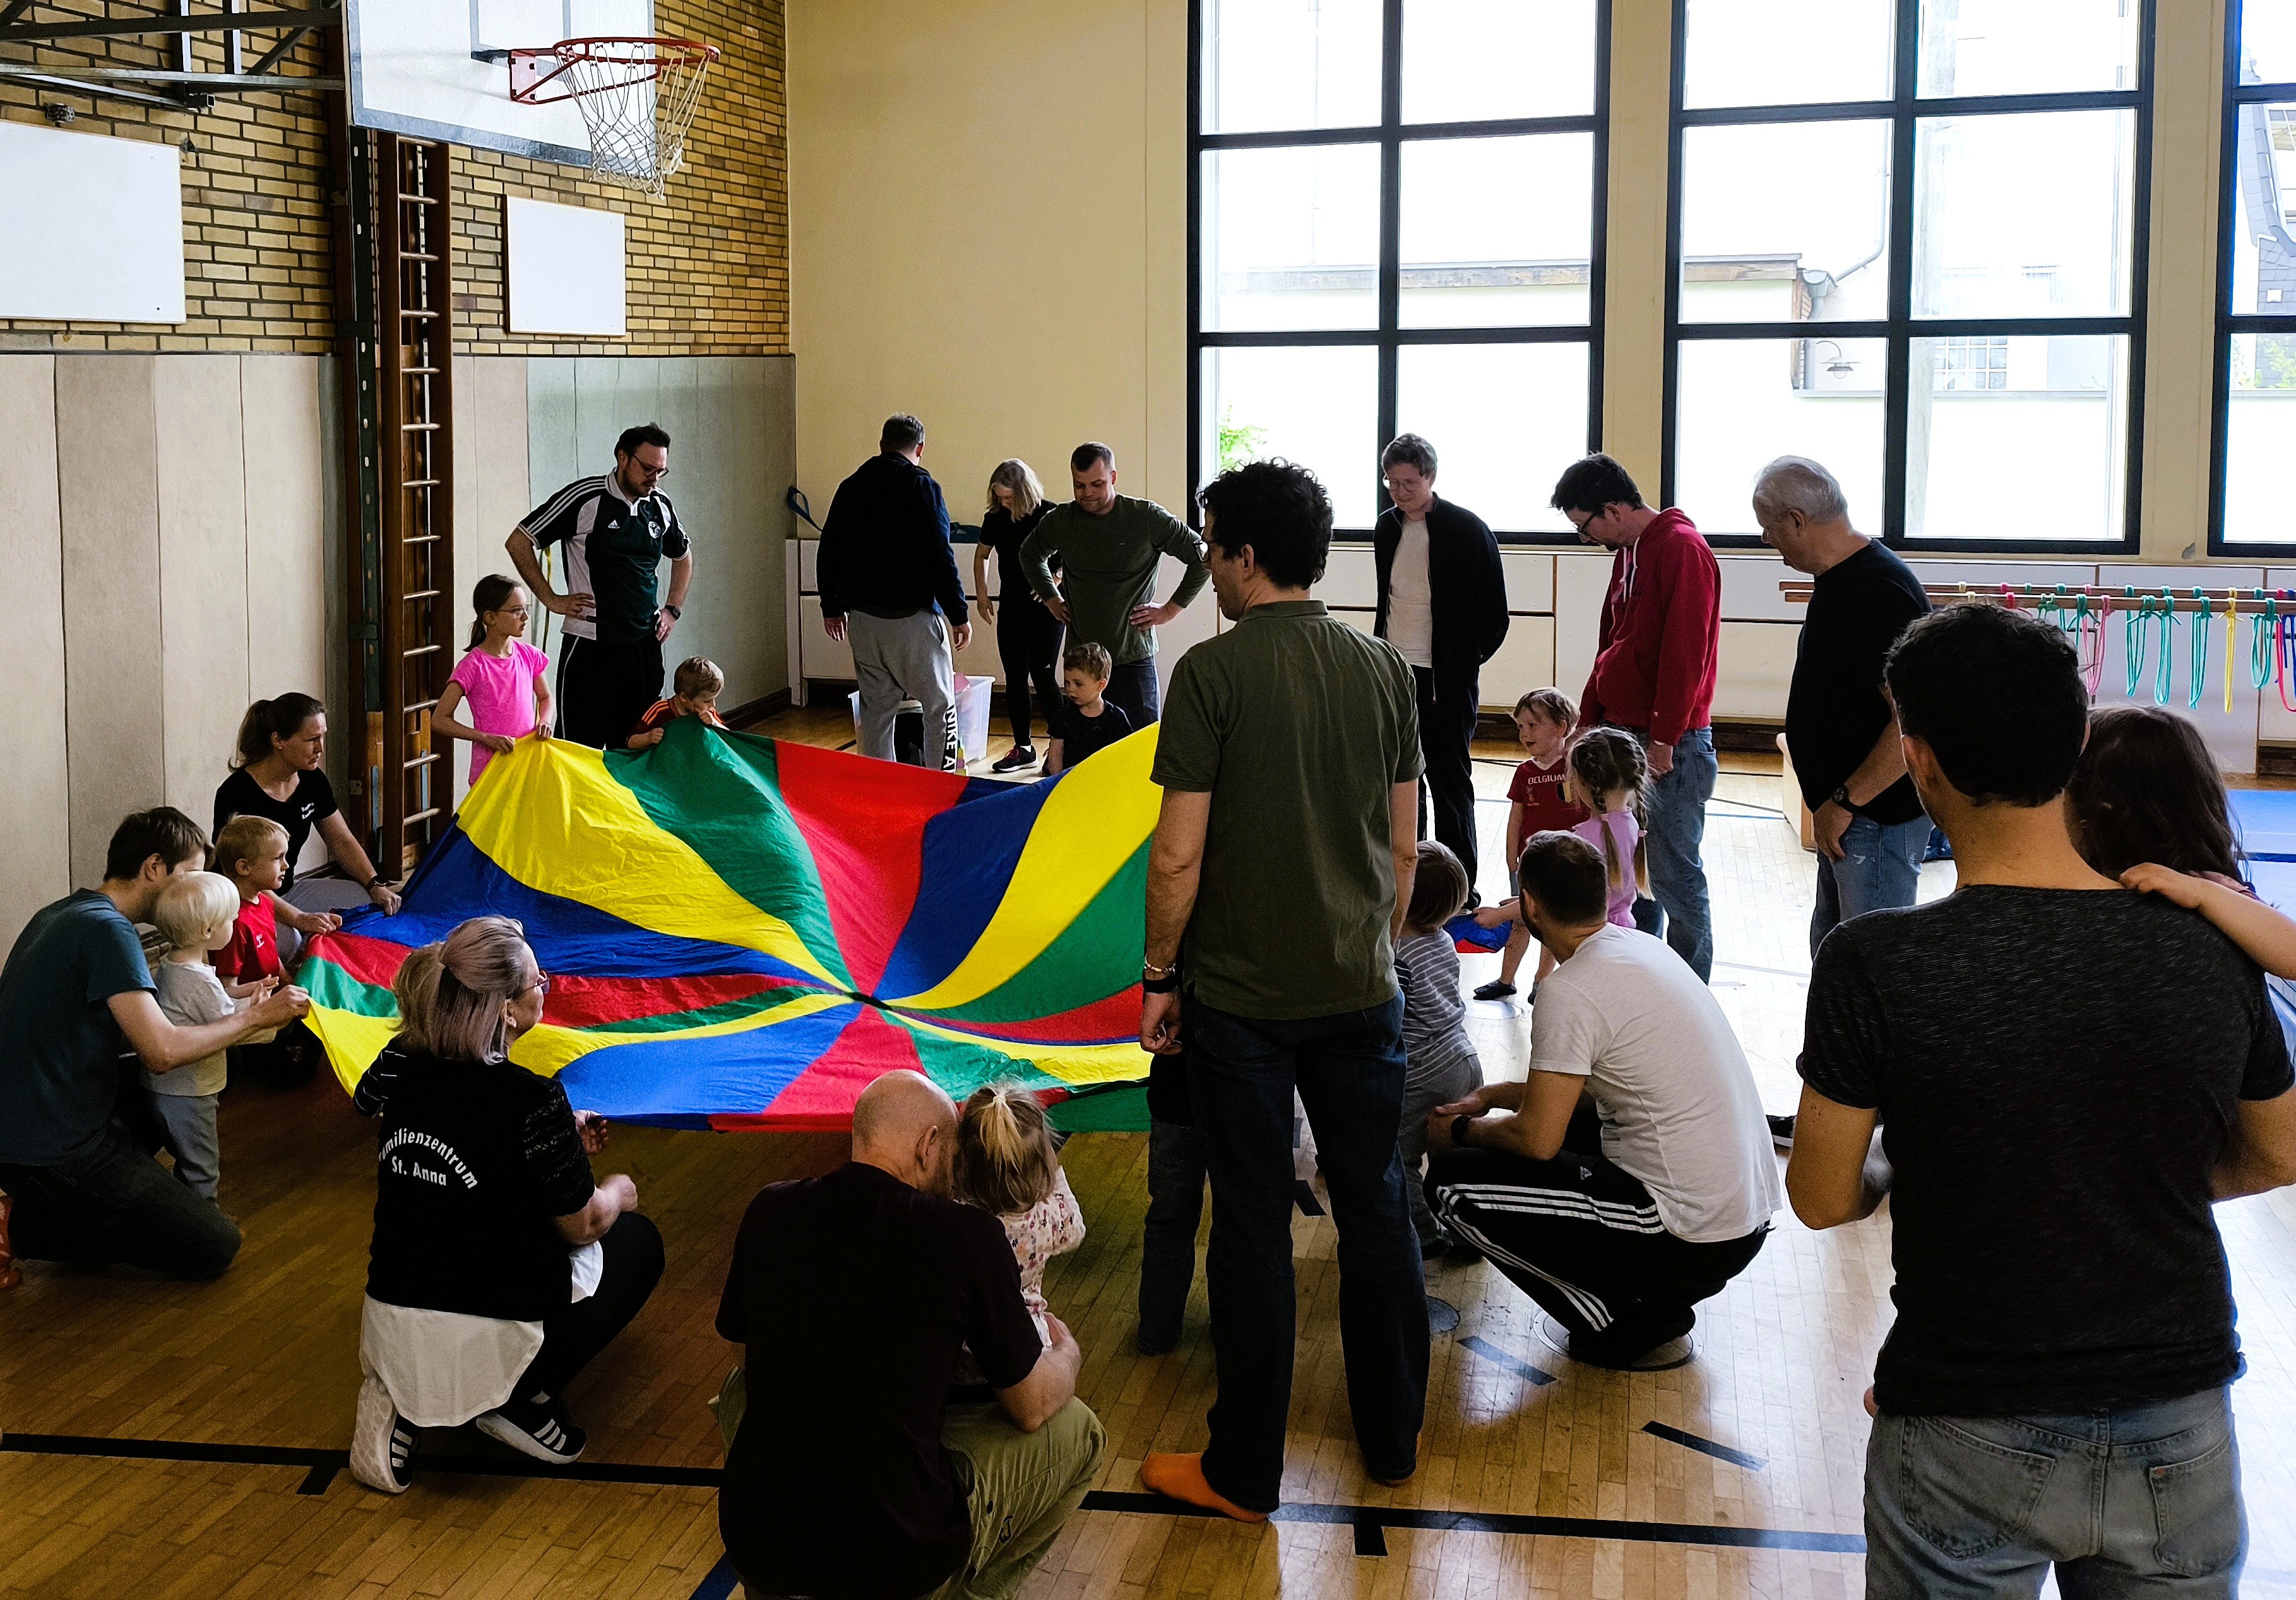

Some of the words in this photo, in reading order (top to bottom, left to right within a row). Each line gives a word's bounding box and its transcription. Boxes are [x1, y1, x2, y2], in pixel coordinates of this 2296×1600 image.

[946, 708, 956, 750] NIKE
[1528, 773, 1566, 785] BELGIUM
[391, 1155, 407, 1175] St.
[412, 1161, 447, 1187] Anna
